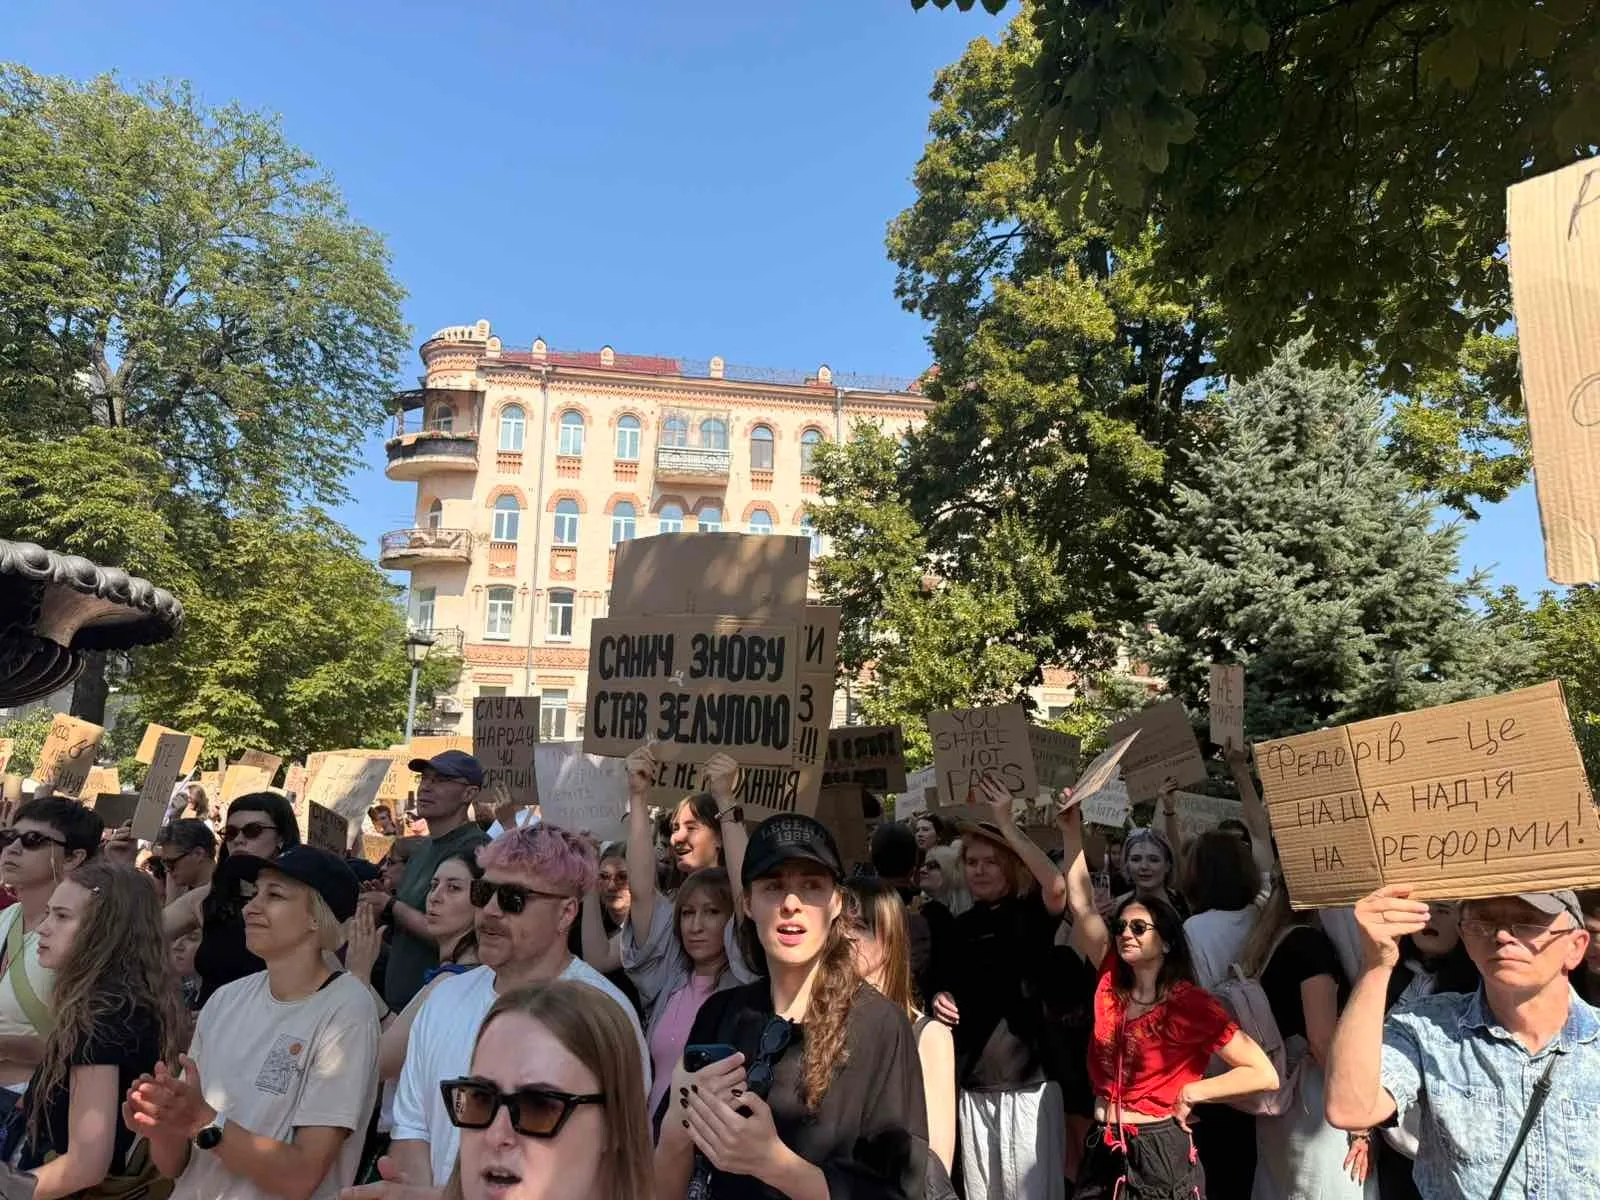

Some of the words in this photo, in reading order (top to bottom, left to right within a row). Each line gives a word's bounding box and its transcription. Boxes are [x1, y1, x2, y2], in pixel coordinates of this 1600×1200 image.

[599, 633, 674, 680] САНИЧ
[475, 698, 524, 720] СЛУГА
[594, 691, 648, 740] СТАВ
[657, 691, 790, 750] ЗЕЛУПОЮ
[952, 710, 1001, 731] YOU
[477, 727, 535, 748] НАРОДУ
[1297, 791, 1390, 828] НАША
[1412, 770, 1514, 813] НАДІЯ
[1312, 847, 1344, 873] НА
